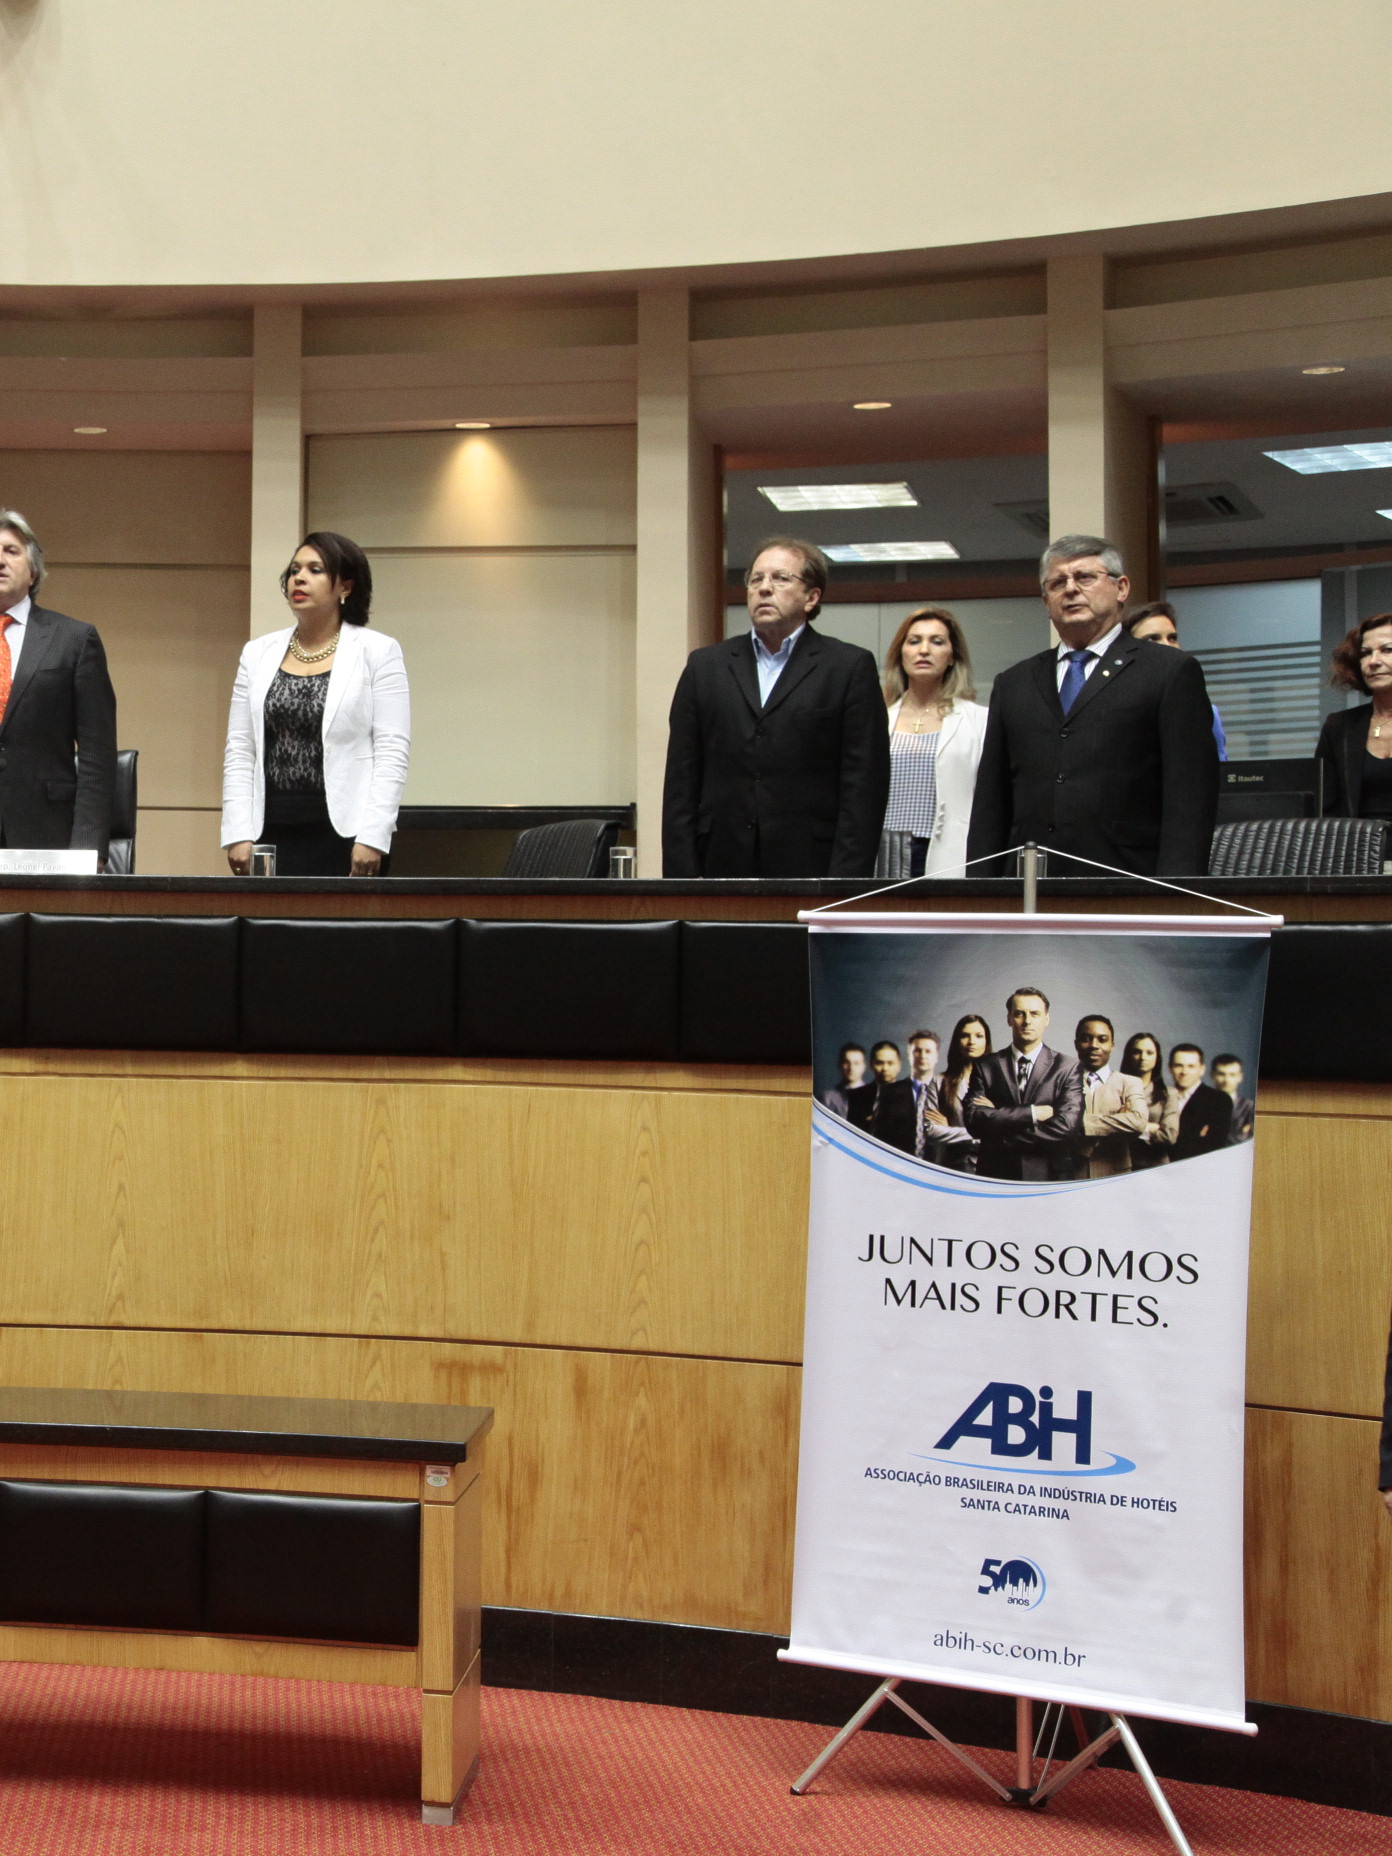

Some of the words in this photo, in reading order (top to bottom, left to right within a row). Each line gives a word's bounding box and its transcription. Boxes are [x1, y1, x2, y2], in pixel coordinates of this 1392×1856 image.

[858, 1234, 1020, 1275] JUNTOS
[1033, 1243, 1200, 1285] SOMOS
[884, 1278, 981, 1313] MAIS
[997, 1286, 1169, 1329] FORTES.
[864, 1467, 942, 1487] ASSOCIAÇÃO
[945, 1475, 1015, 1495] BRASILEIRA
[1018, 1484, 1037, 1497] DA
[1039, 1486, 1107, 1505] INDÚSTRIA
[1110, 1494, 1128, 1508] DE
[1131, 1496, 1178, 1514] HOTÉIS
[960, 1497, 1001, 1513] SANTA
[1004, 1502, 1070, 1521] CATARINA
[977, 1558, 1038, 1595] 50
[1007, 1596, 1030, 1607] anos
[933, 1629, 1087, 1667] abih-sc.com.br
